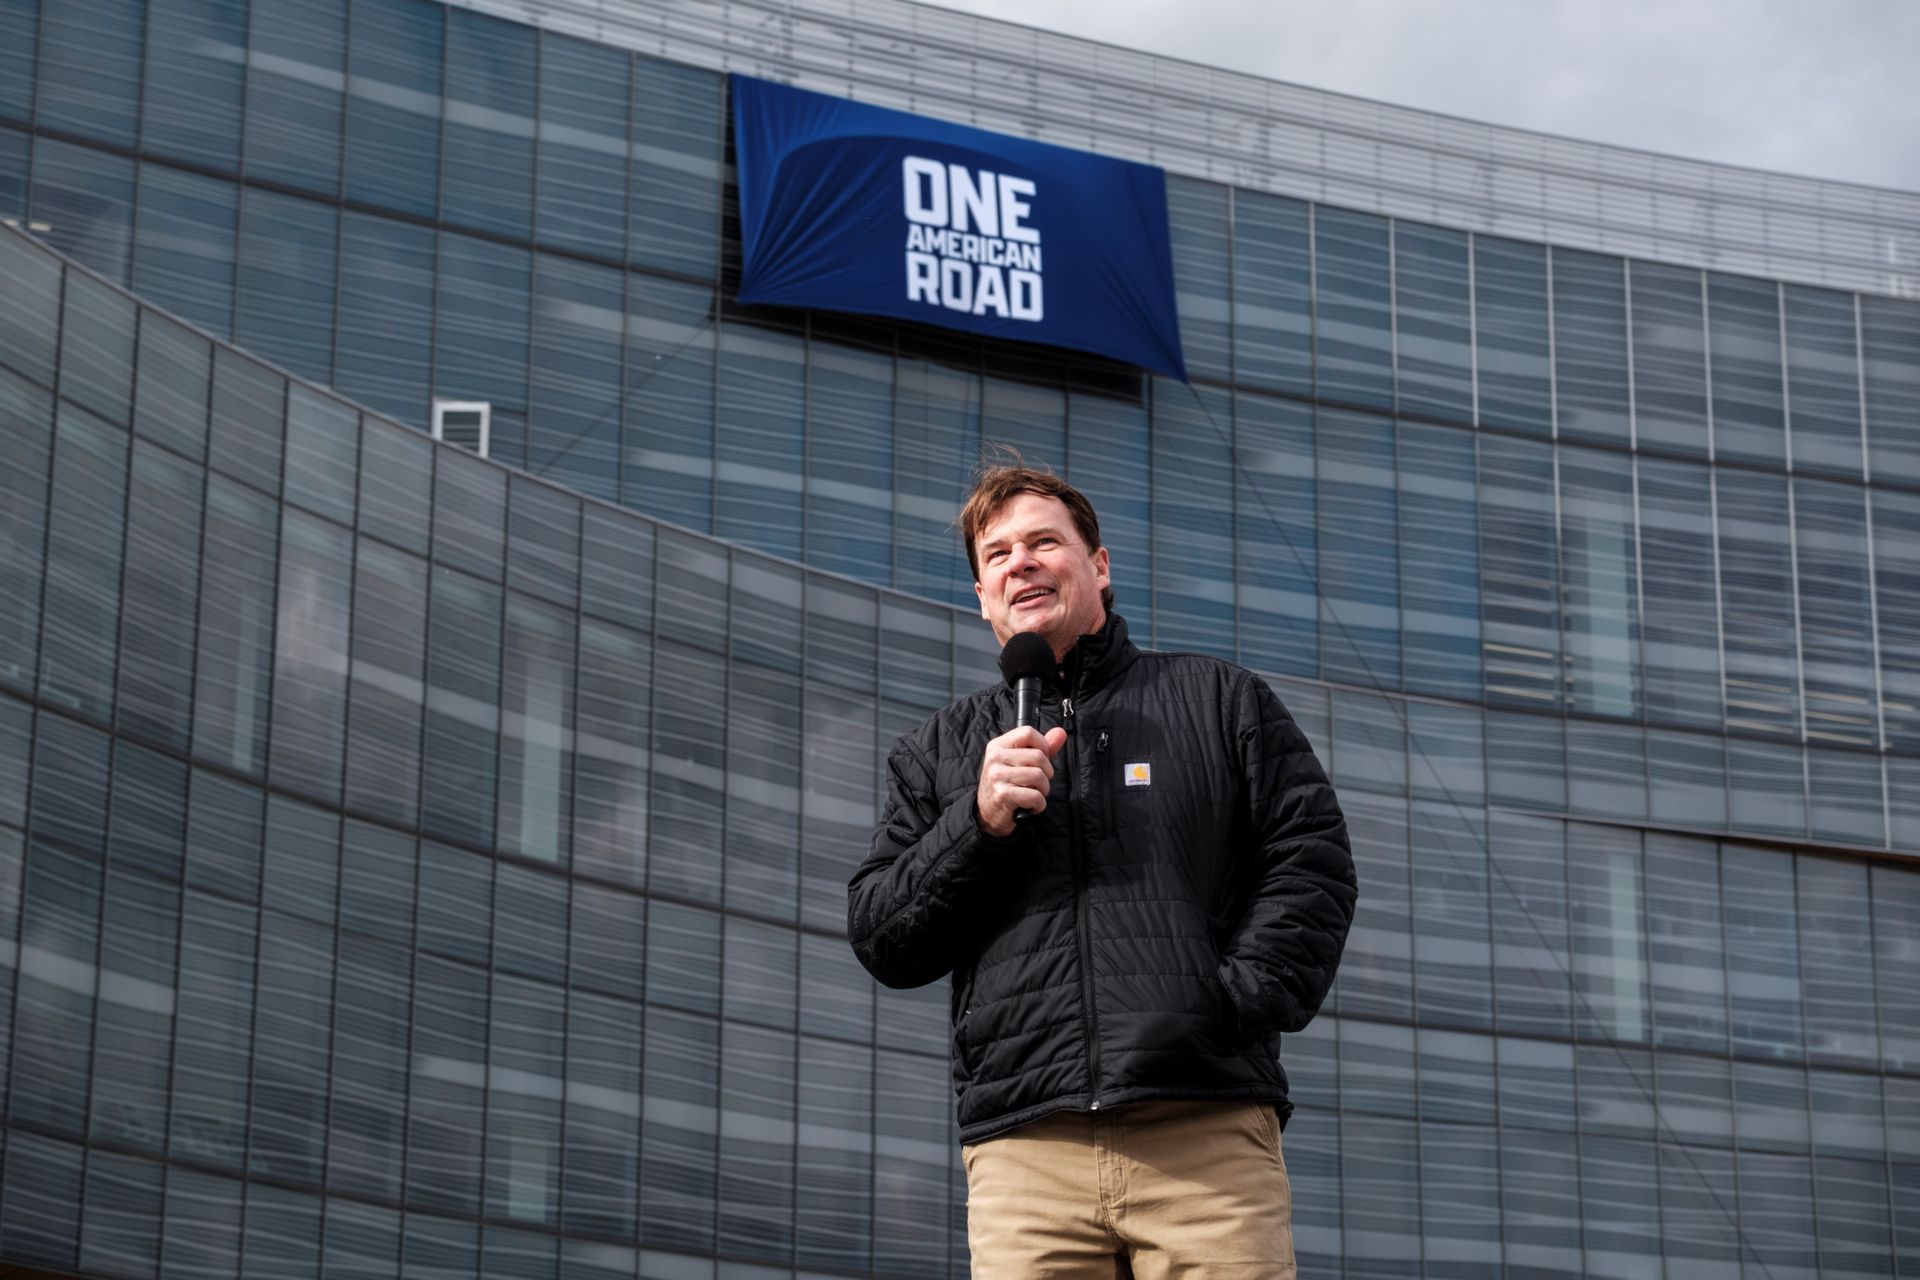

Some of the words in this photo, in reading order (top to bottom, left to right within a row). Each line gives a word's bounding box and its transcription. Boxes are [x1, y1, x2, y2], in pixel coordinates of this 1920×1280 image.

[902, 156, 1042, 245] ONE
[906, 223, 1042, 272] AMERICAN
[905, 250, 1044, 322] ROAD
